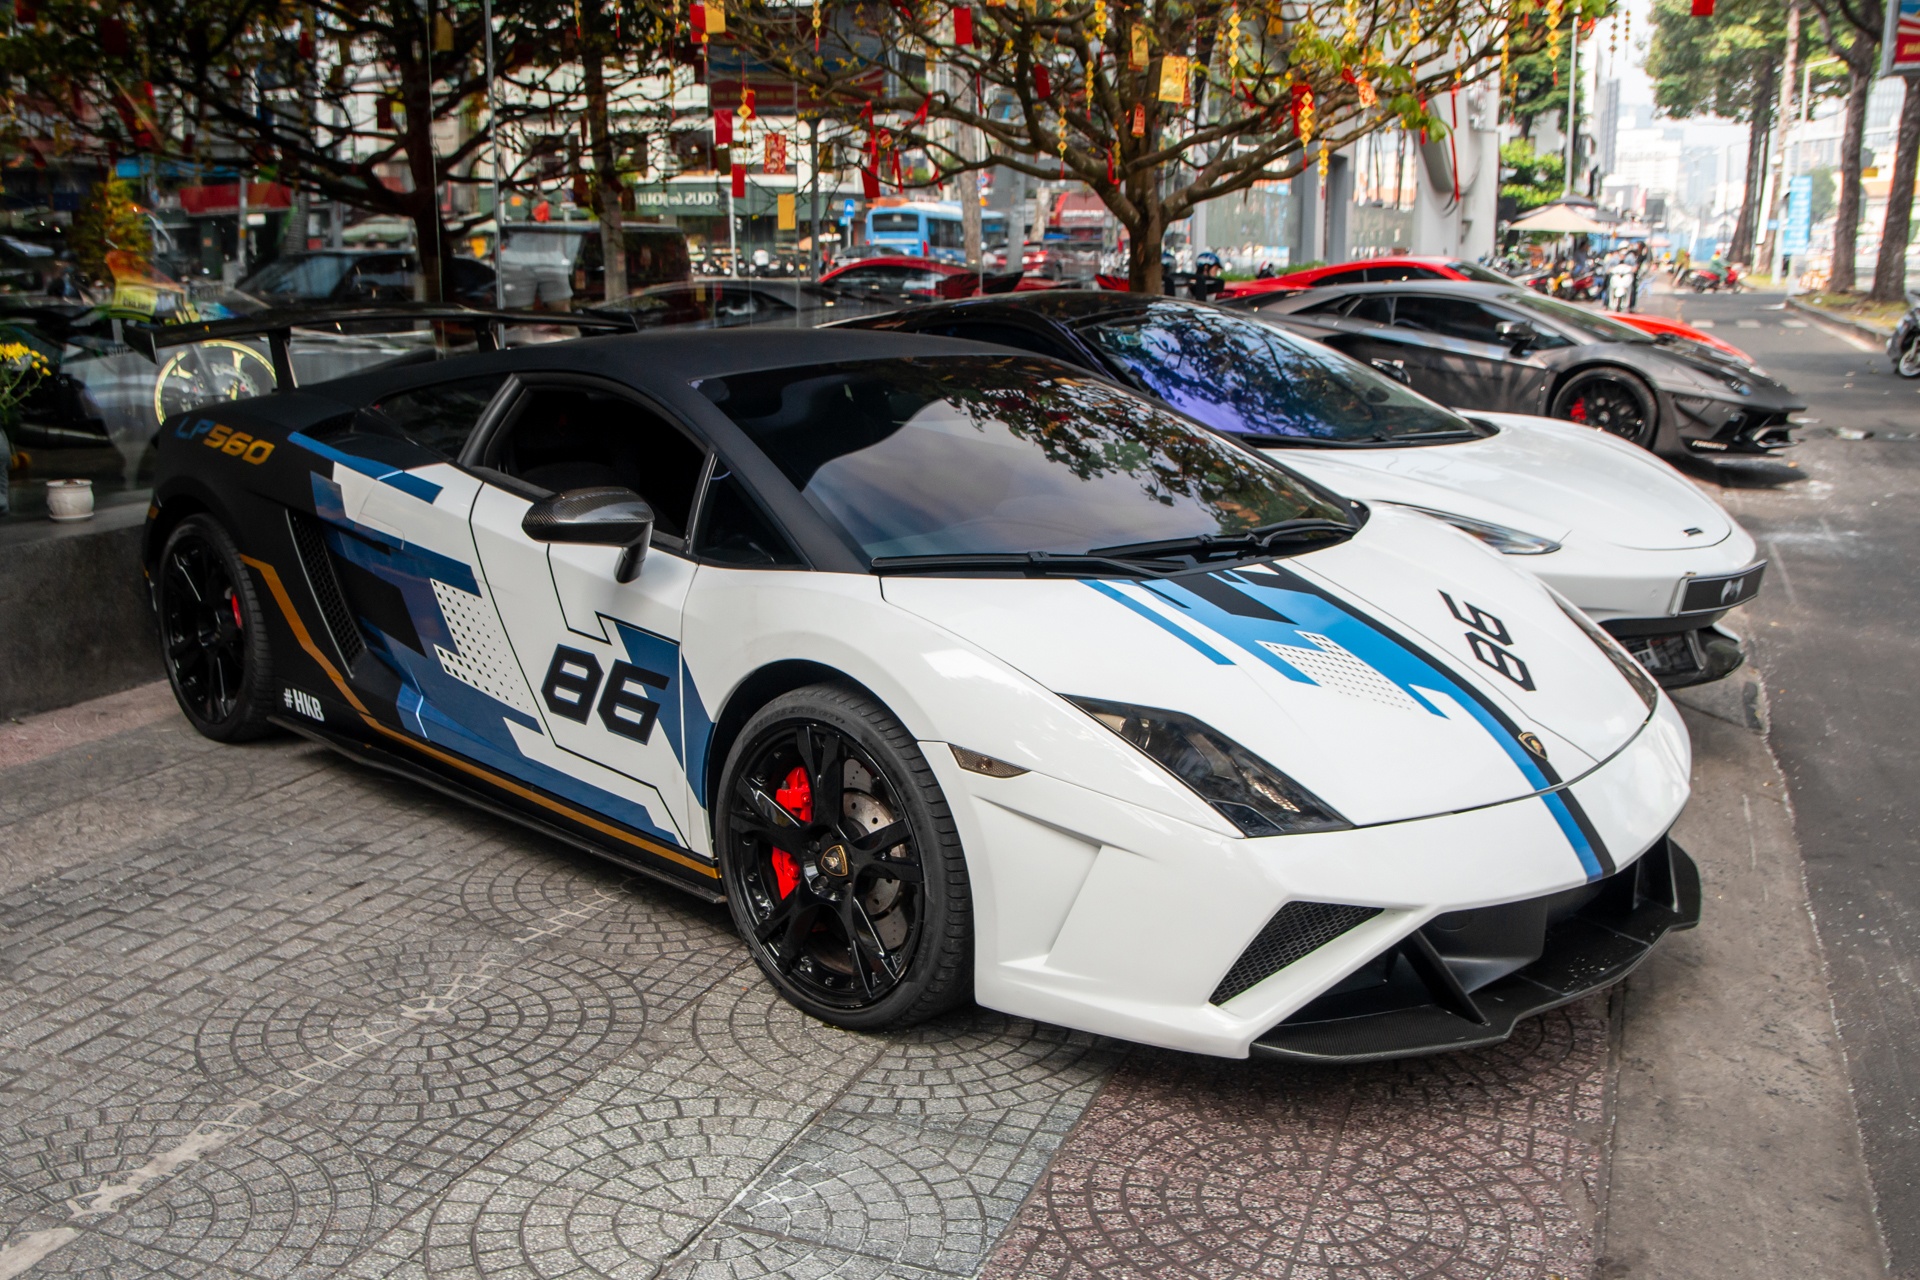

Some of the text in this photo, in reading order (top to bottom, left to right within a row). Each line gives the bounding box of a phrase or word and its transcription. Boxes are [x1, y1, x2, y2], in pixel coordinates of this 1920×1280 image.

[175, 416, 275, 466] LP560
[1437, 588, 1537, 692] 86
[283, 687, 325, 722] #HKB
[540, 643, 670, 746] 86
